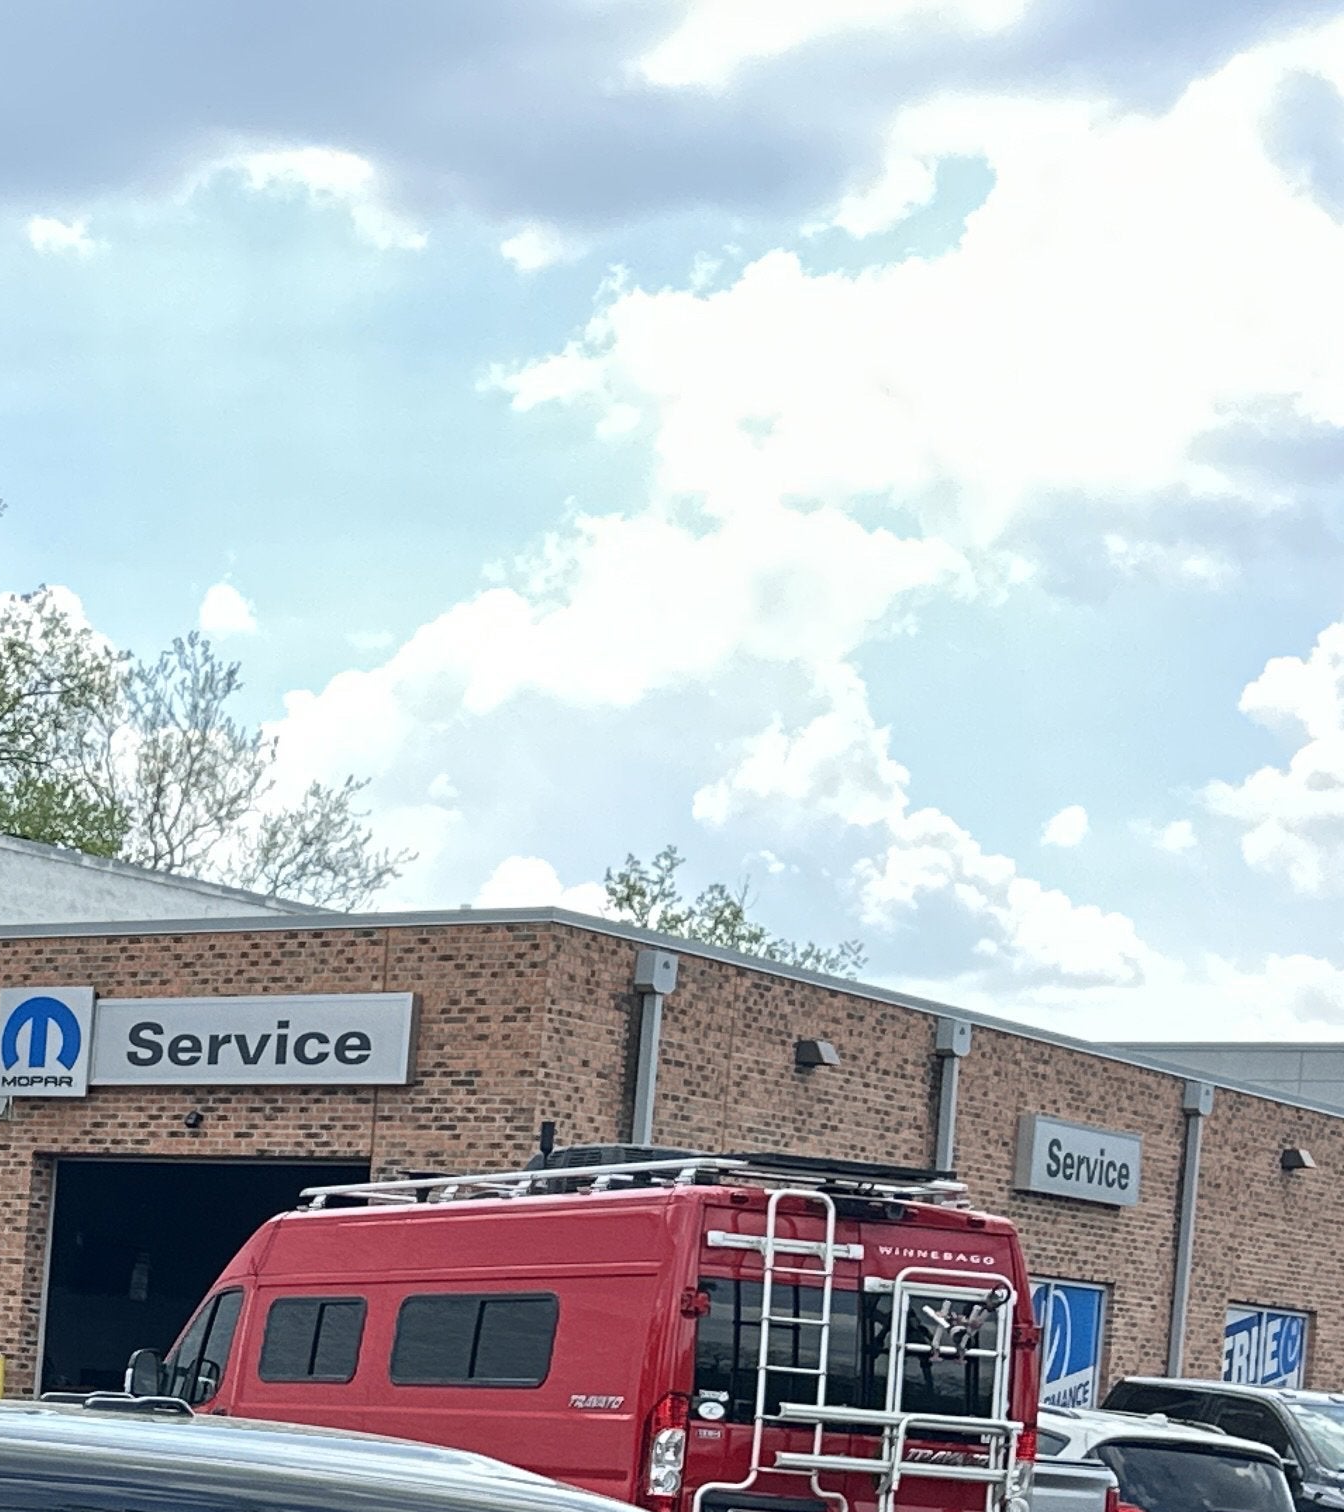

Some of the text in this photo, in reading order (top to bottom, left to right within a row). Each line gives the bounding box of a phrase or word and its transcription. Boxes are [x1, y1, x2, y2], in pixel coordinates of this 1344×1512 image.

[126, 1020, 372, 1067] Service
[1, 1076, 73, 1088] MOPAR
[1046, 1138, 1130, 1190] Service
[878, 1245, 995, 1265] WINNEBAGO
[568, 1394, 625, 1409] TRAVATO
